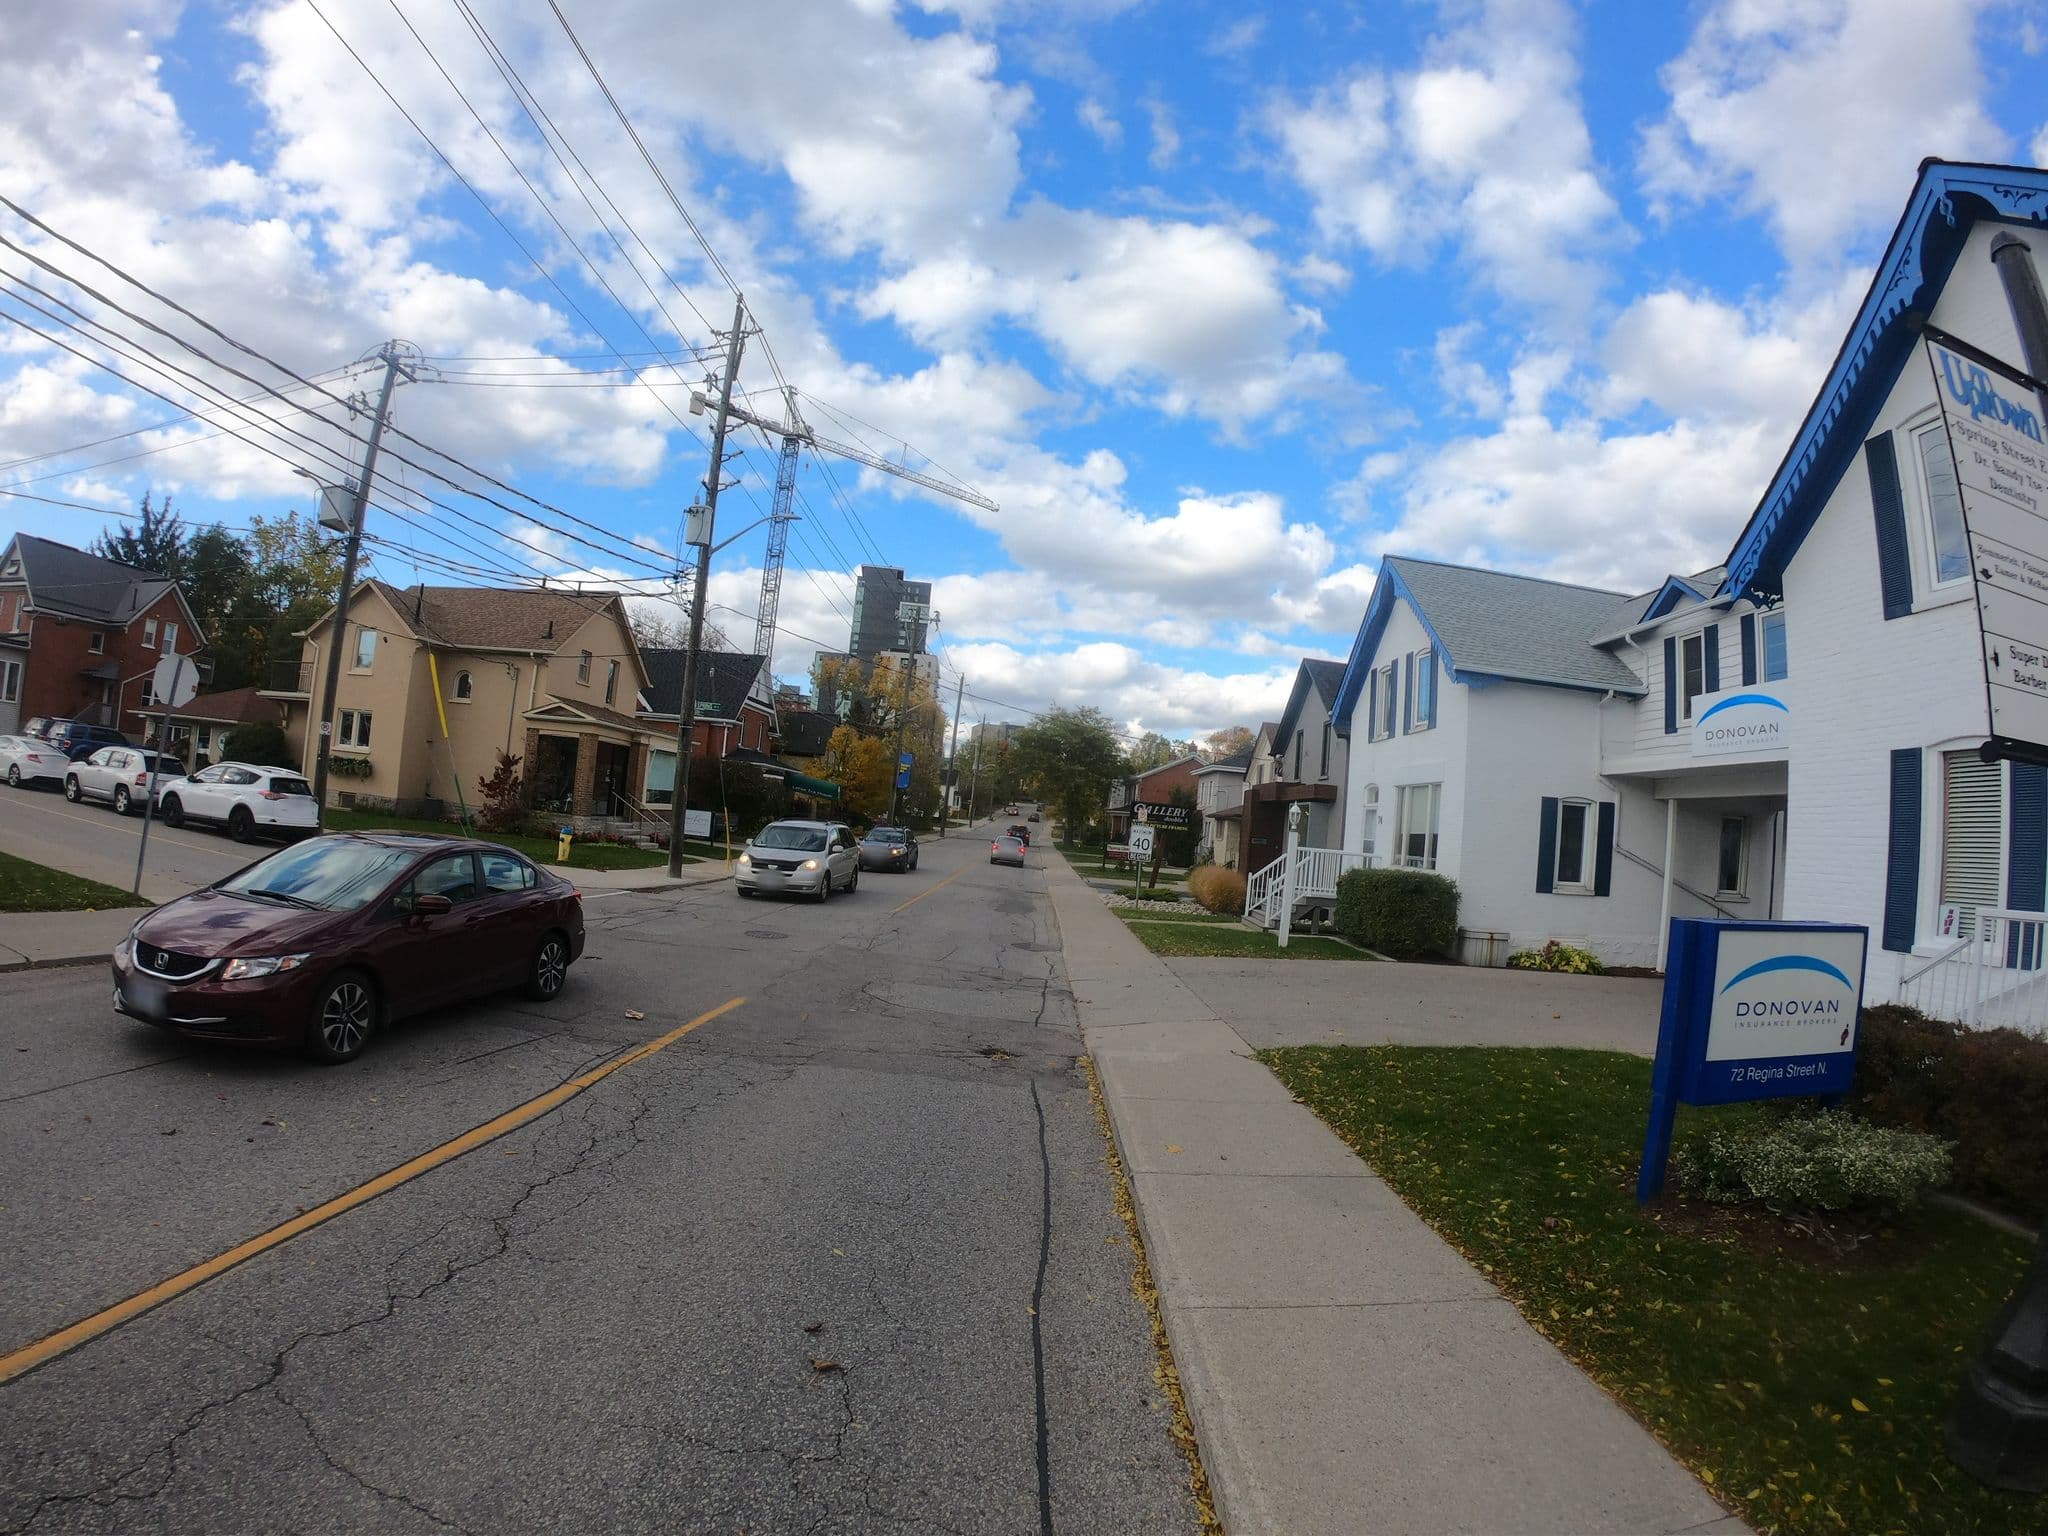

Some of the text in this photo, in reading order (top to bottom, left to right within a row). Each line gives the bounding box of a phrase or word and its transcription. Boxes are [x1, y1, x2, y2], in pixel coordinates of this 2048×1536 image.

[1955, 420, 1999, 454] Spring
[2001, 440, 2037, 470] Street
[1988, 475, 2038, 511] Dentistry
[2010, 645, 2039, 666] Super
[2013, 669, 2046, 690] Barber
[1705, 722, 1779, 741] DONOVAN
[1132, 837, 1151, 851] 40
[1736, 1000, 1839, 1017] DONOVAN
[1734, 1020, 1791, 1029] INSURANCE
[1730, 1068, 1745, 1082] 72
[1746, 1066, 1784, 1083] Regina
[1785, 1063, 1816, 1078] Street
